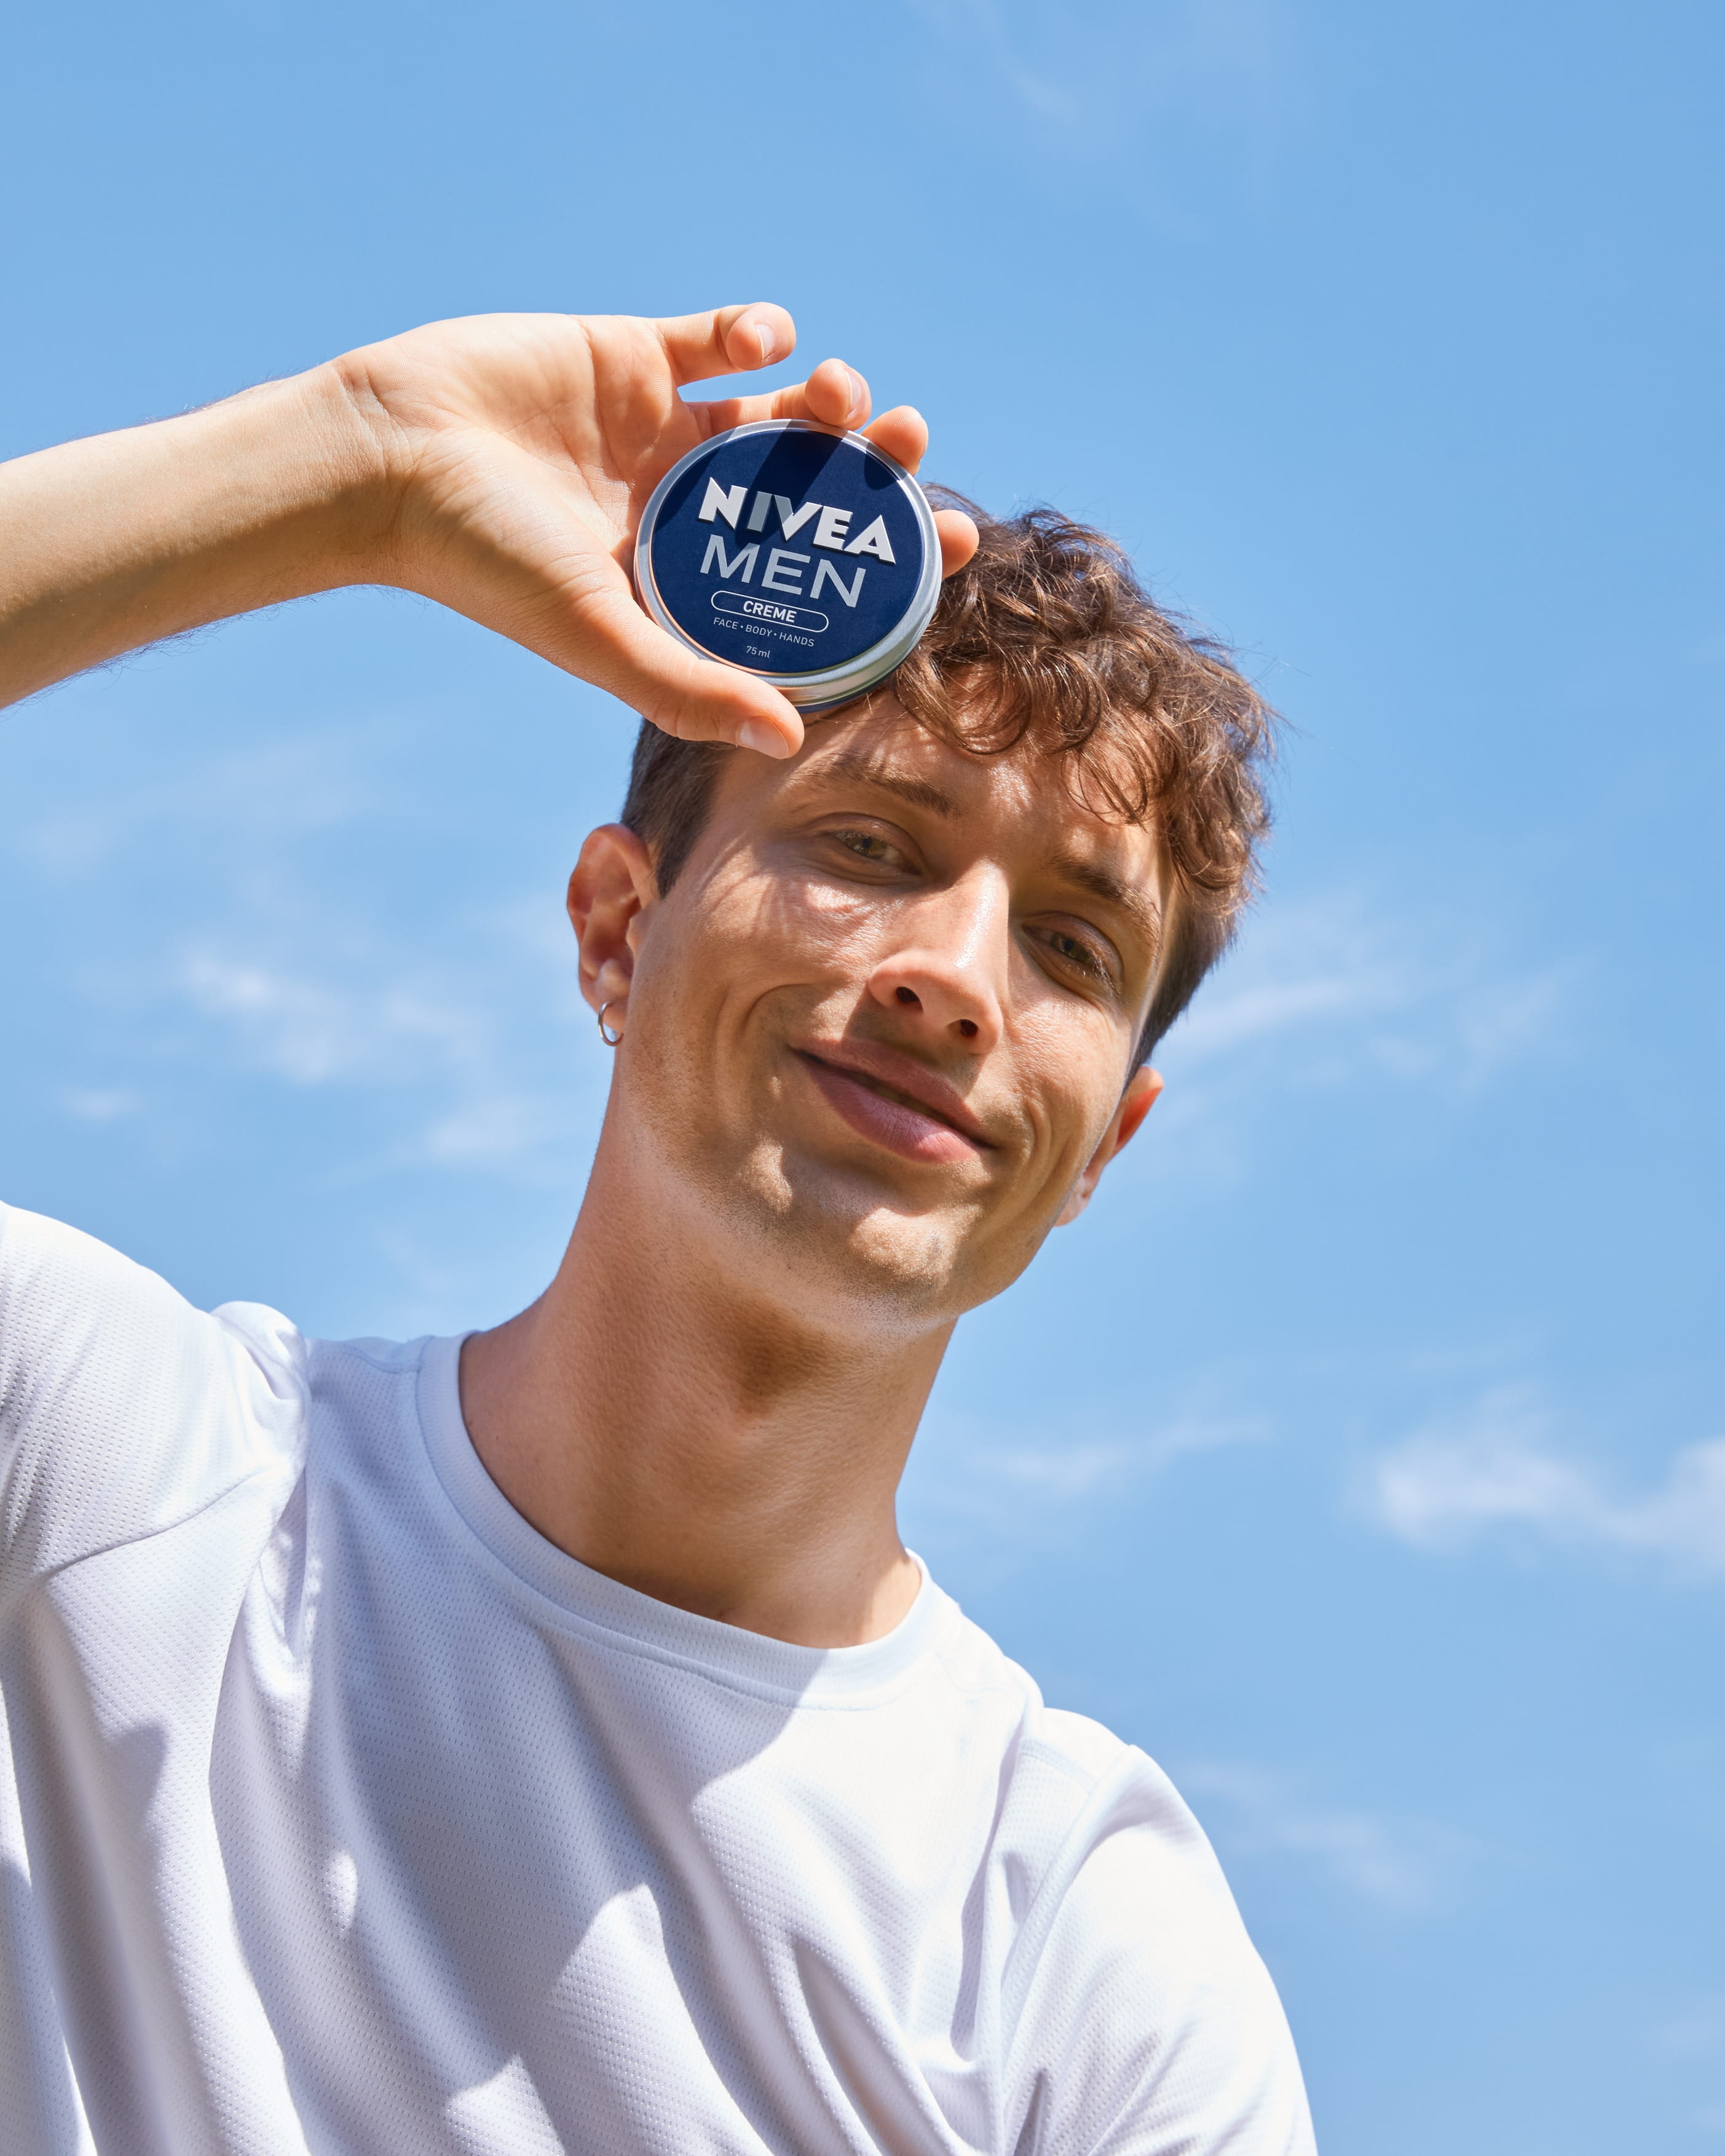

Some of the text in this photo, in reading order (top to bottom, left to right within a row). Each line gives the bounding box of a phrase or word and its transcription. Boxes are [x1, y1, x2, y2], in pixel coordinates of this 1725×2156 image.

[698, 477, 896, 564] NIVEA
[700, 534, 866, 608] MEN
[743, 600, 797, 623] CREME
[713, 617, 815, 647] FACE BODY HANDS
[746, 645, 770, 658] 75 ml
